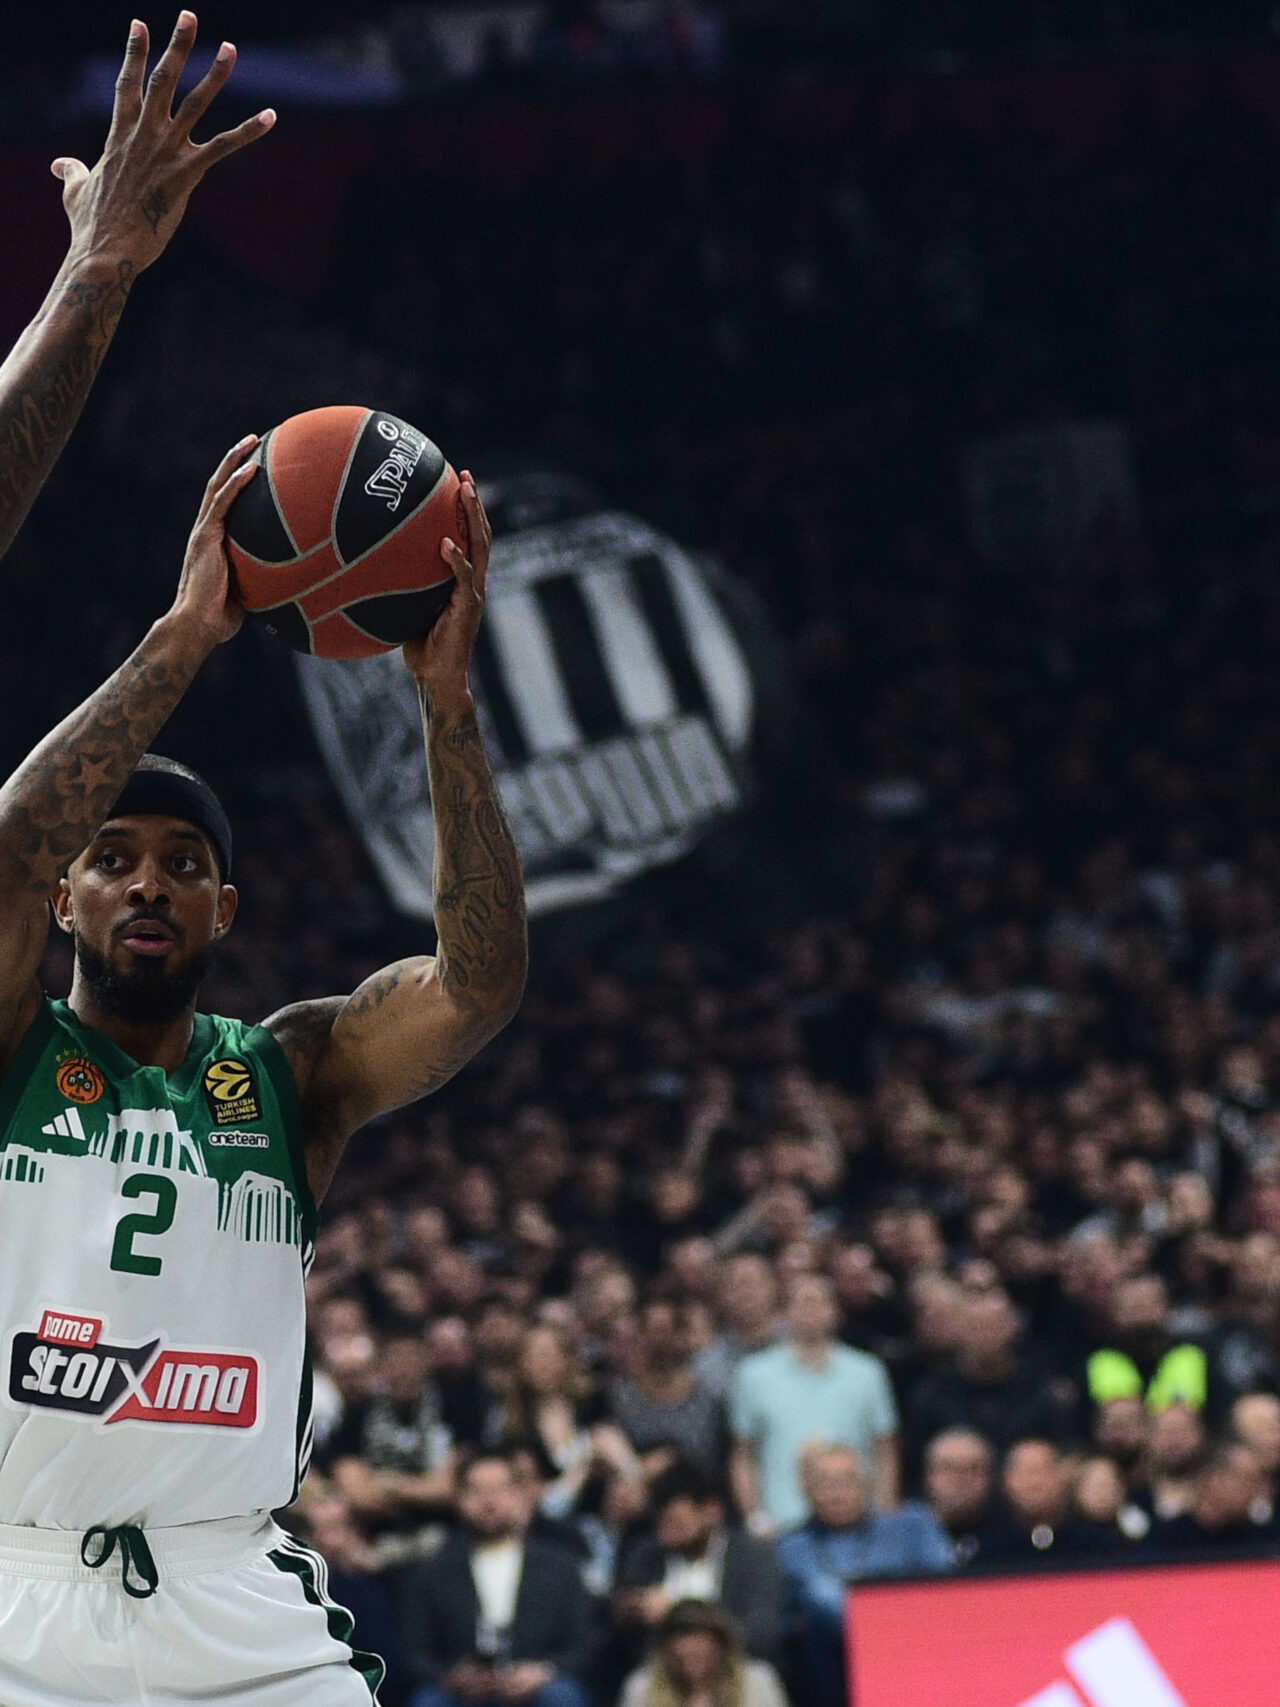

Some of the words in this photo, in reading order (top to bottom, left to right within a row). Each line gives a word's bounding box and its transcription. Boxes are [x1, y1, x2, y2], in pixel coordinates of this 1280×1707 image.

[214, 1096, 256, 1111] TURKISH
[217, 1104, 258, 1118] AIRLINES
[109, 1172, 179, 1278] 2
[43, 1315, 95, 1343] pame
